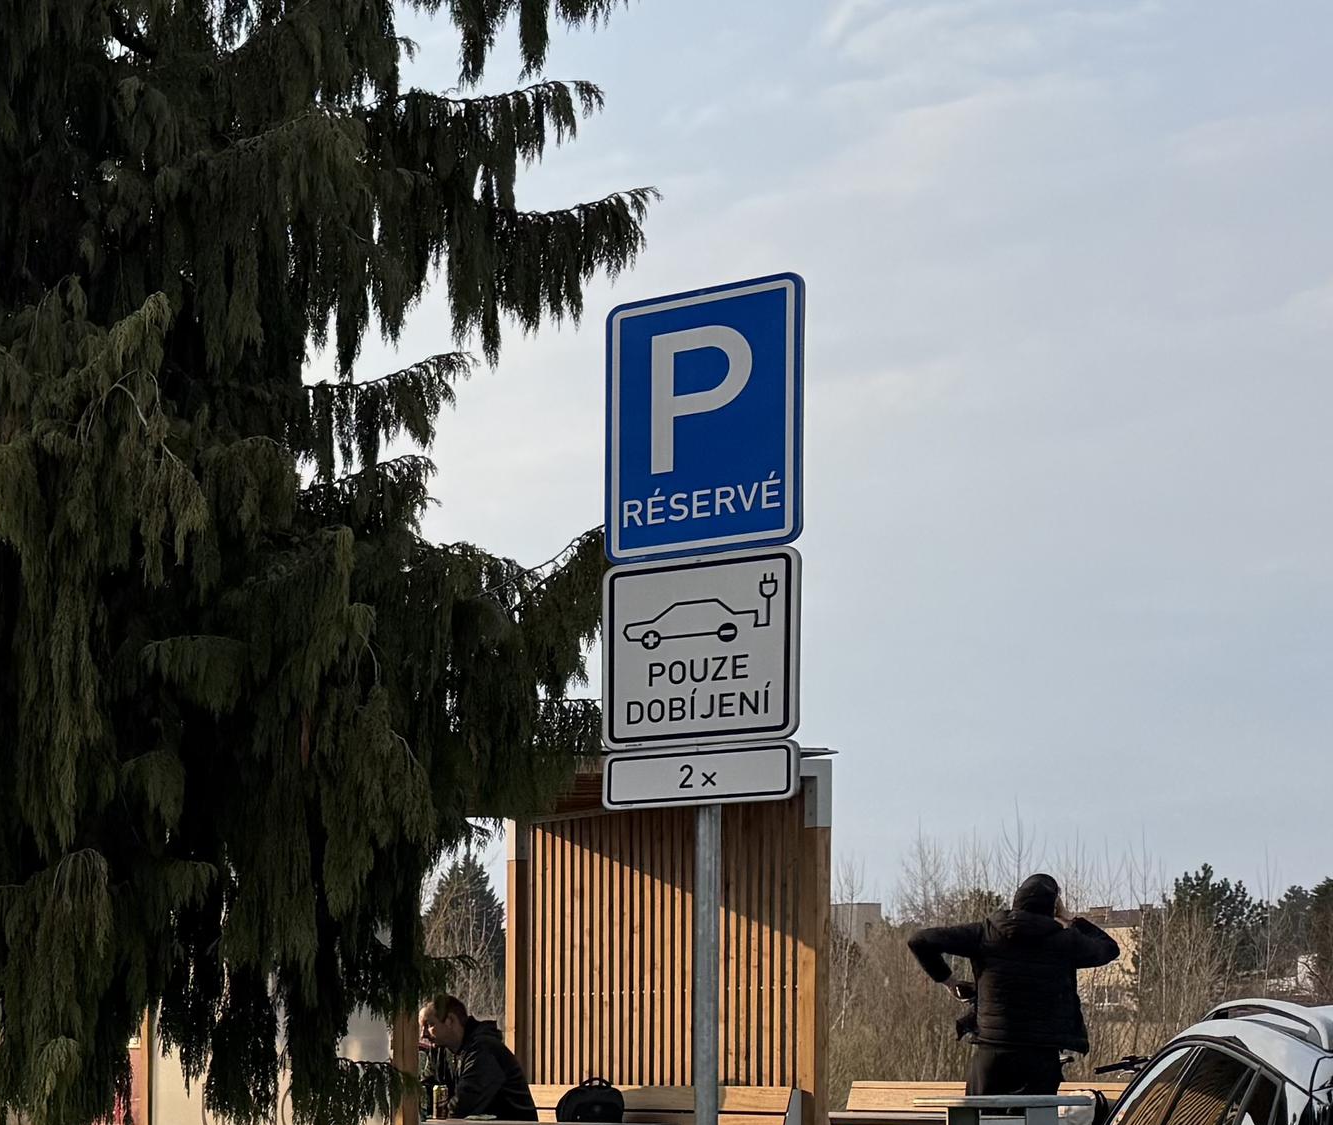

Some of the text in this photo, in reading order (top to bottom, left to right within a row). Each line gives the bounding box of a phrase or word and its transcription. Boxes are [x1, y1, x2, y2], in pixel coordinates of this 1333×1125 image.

[651, 325, 753, 475] P
[623, 470, 781, 528] RÉSERVÉ
[648, 654, 749, 687] POUZE
[626, 681, 771, 725] DOBÍJENÍ
[679, 764, 694, 789] 2
